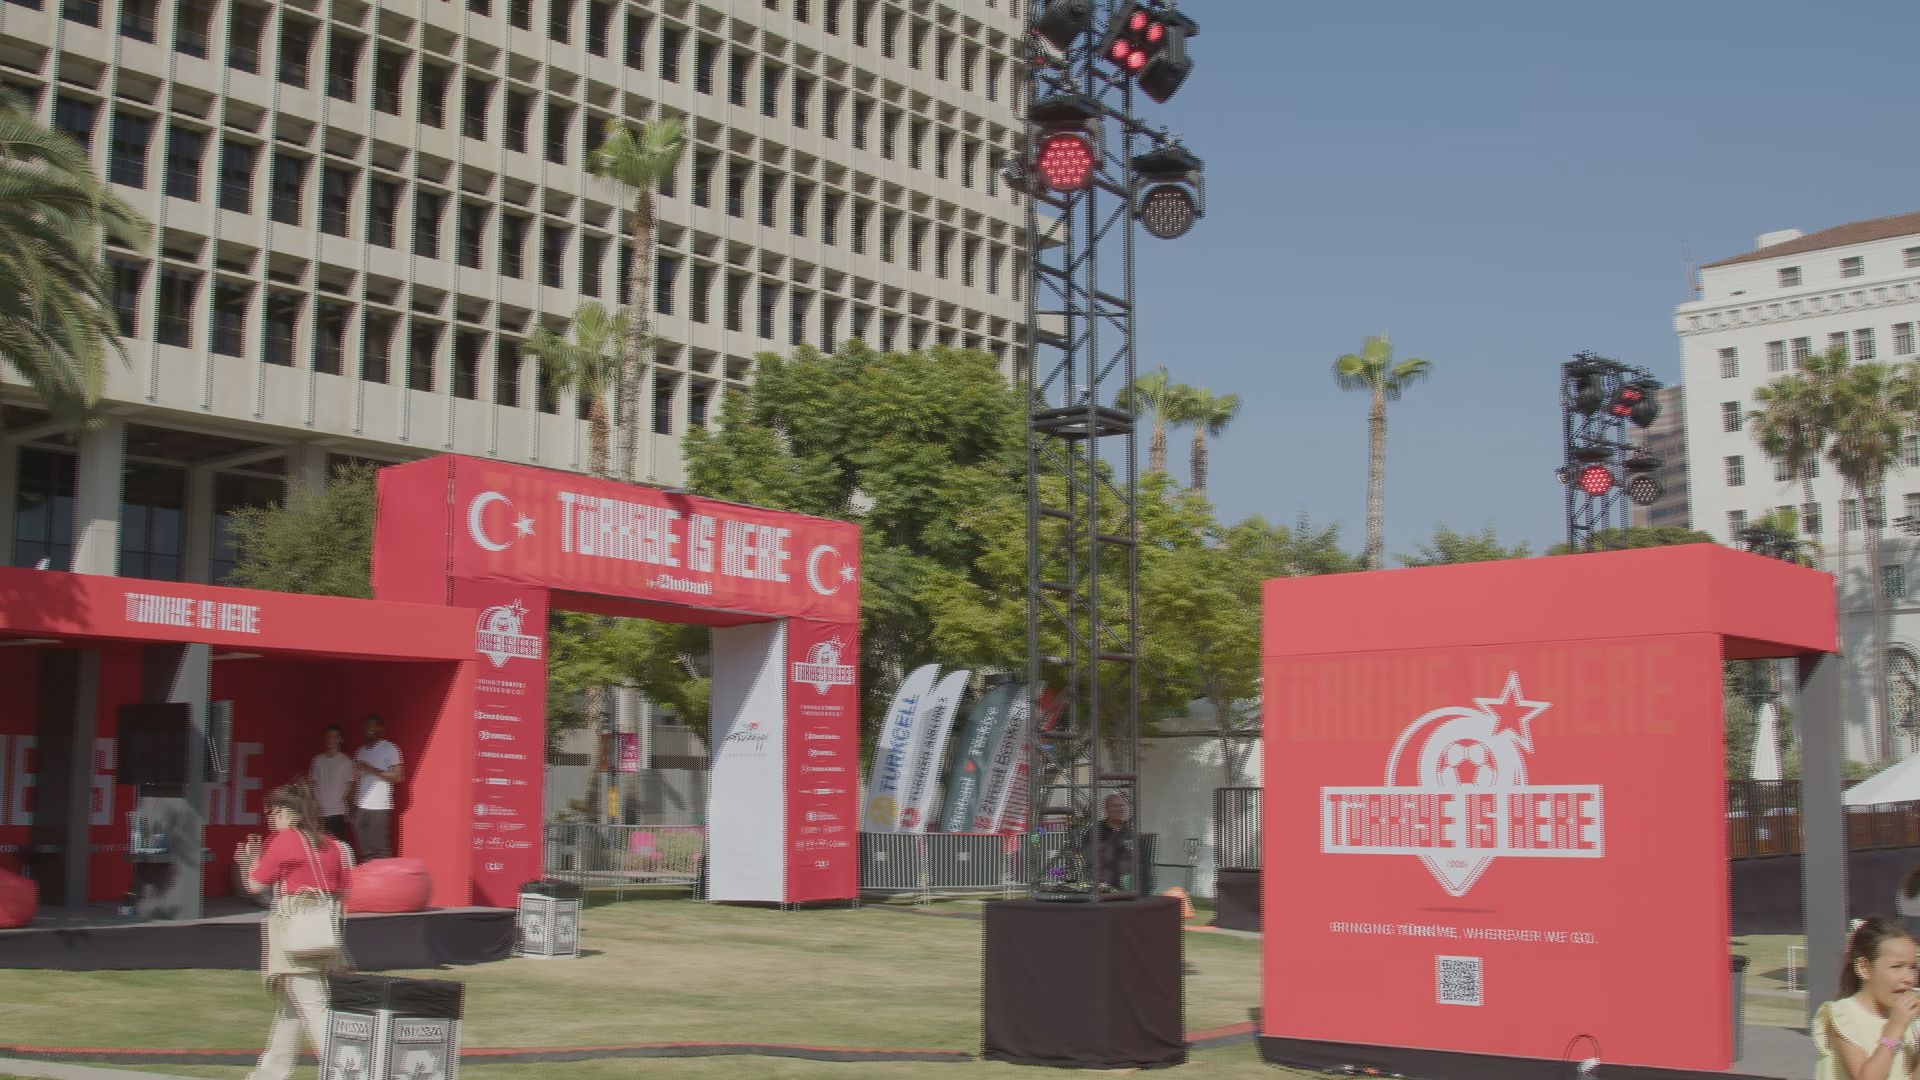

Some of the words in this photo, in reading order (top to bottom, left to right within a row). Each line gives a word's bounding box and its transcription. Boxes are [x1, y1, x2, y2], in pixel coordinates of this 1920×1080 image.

[687, 513, 716, 573] IS
[721, 519, 791, 583] HERE
[657, 574, 712, 595] Chobani
[196, 600, 217, 629] IS
[217, 602, 261, 634] HERE
[879, 694, 920, 792] TURKCELL
[909, 746, 933, 802] TURKISH
[924, 696, 949, 747] AIRLINES
[948, 776, 976, 832] Chobani
[979, 767, 1007, 815] Ziraat
[1464, 793, 1498, 849] IS
[1507, 792, 1598, 850] HERE
[1329, 921, 1395, 936] BRINGING
[1463, 927, 1542, 942] WHEREVER
[1543, 930, 1569, 943] WE
